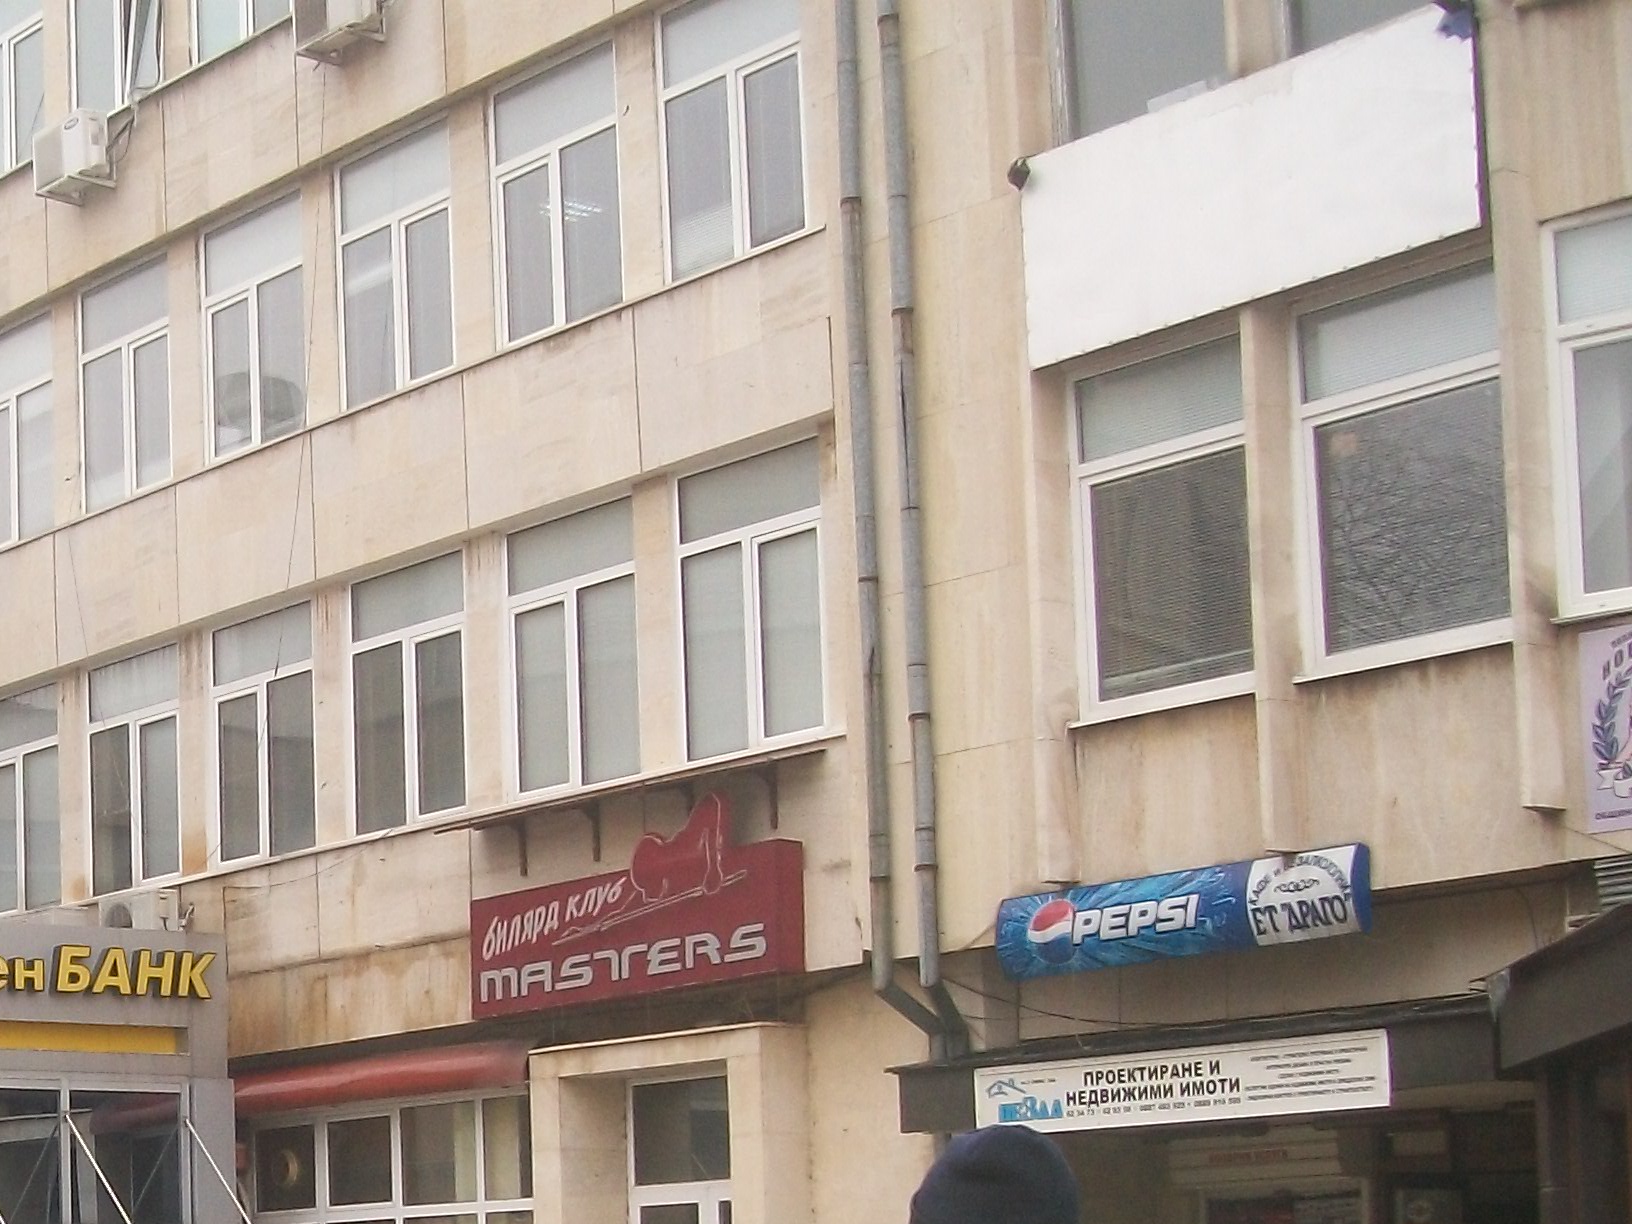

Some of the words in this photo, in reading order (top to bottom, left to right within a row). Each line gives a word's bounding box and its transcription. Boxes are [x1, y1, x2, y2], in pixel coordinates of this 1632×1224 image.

[1070, 893, 1200, 945] PEPSI
[54, 944, 218, 1000] БАНК
[479, 922, 767, 1003] MASTERS
[1066, 1083, 1175, 1107] НЕДВИЖИМИ
[1179, 1077, 1241, 1097] ИМОТИ
[1083, 1060, 1204, 1087] ПРОЕКТИРАНЕ
[1208, 1059, 1221, 1076] И
